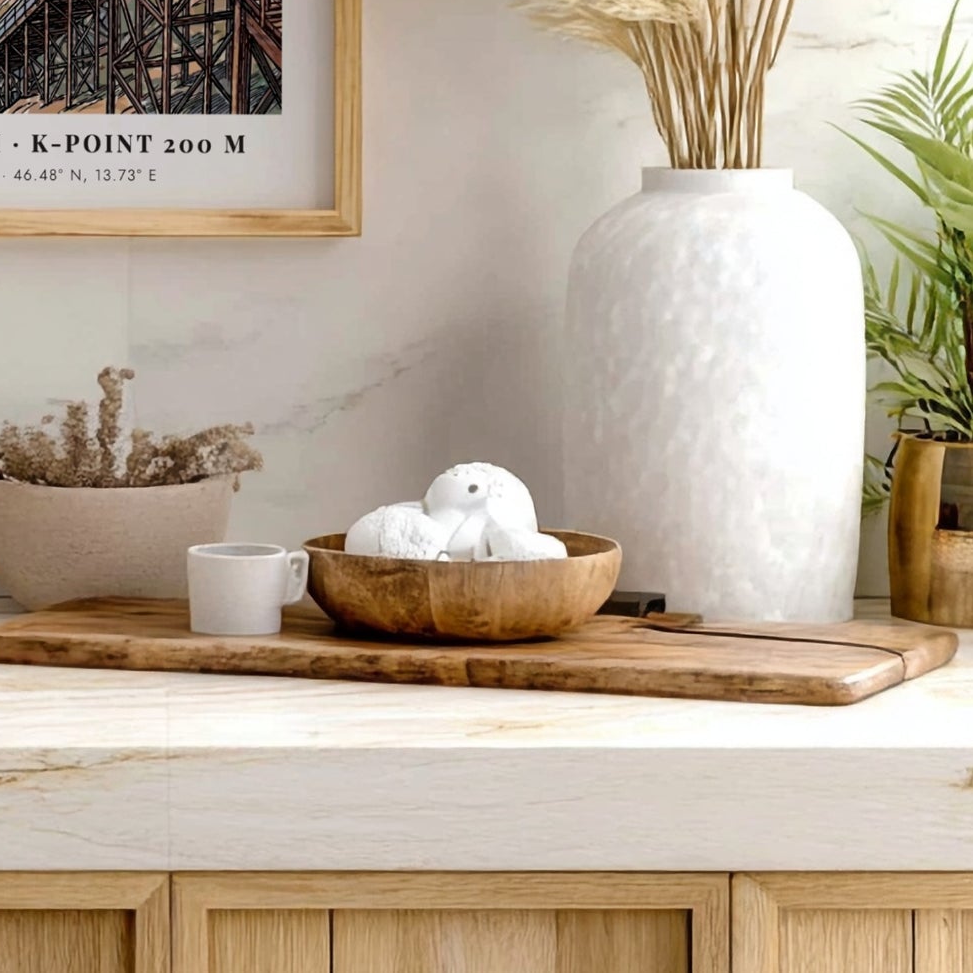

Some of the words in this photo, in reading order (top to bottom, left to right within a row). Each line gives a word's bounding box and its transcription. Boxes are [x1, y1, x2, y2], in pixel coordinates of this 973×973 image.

[31, 132, 153, 154] K-POINT
[163, 137, 213, 155] 200
[224, 133, 246, 154] M
[13, 167, 64, 182] 46.48°
[70, 168, 87, 184] N,
[95, 167, 143, 182] 13.73°
[148, 168, 157, 182] E
